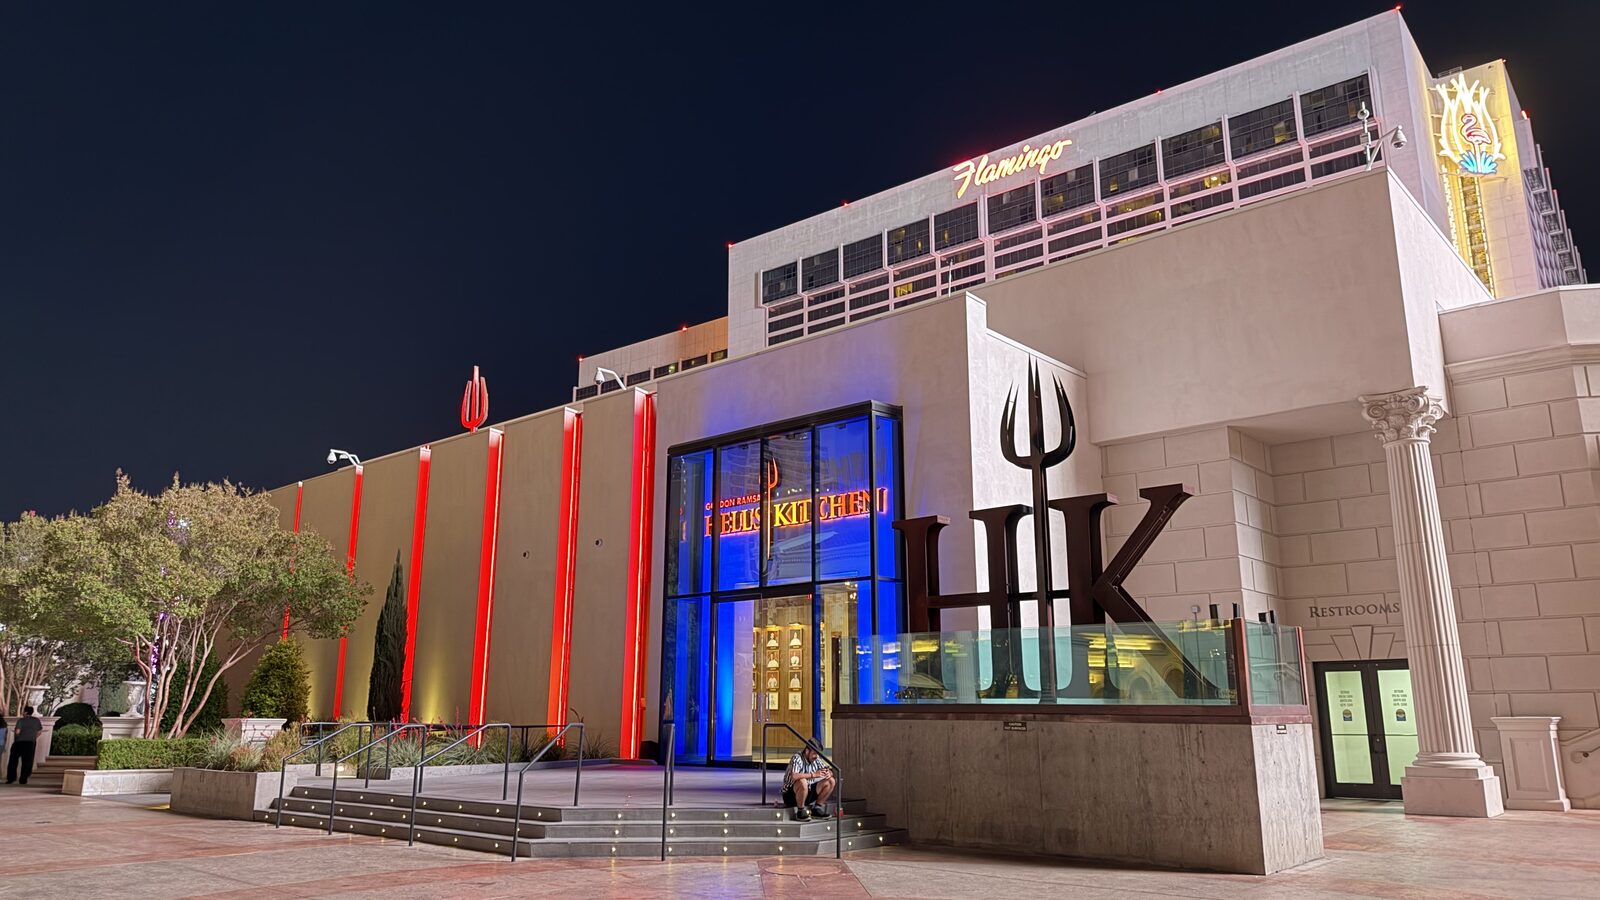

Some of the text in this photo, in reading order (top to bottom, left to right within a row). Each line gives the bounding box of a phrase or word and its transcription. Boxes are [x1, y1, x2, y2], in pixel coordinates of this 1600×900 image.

[952, 139, 1073, 199] Flamingo
[705, 494, 760, 510] GDON RAMSA
[773, 487, 888, 528] KITCHEN
